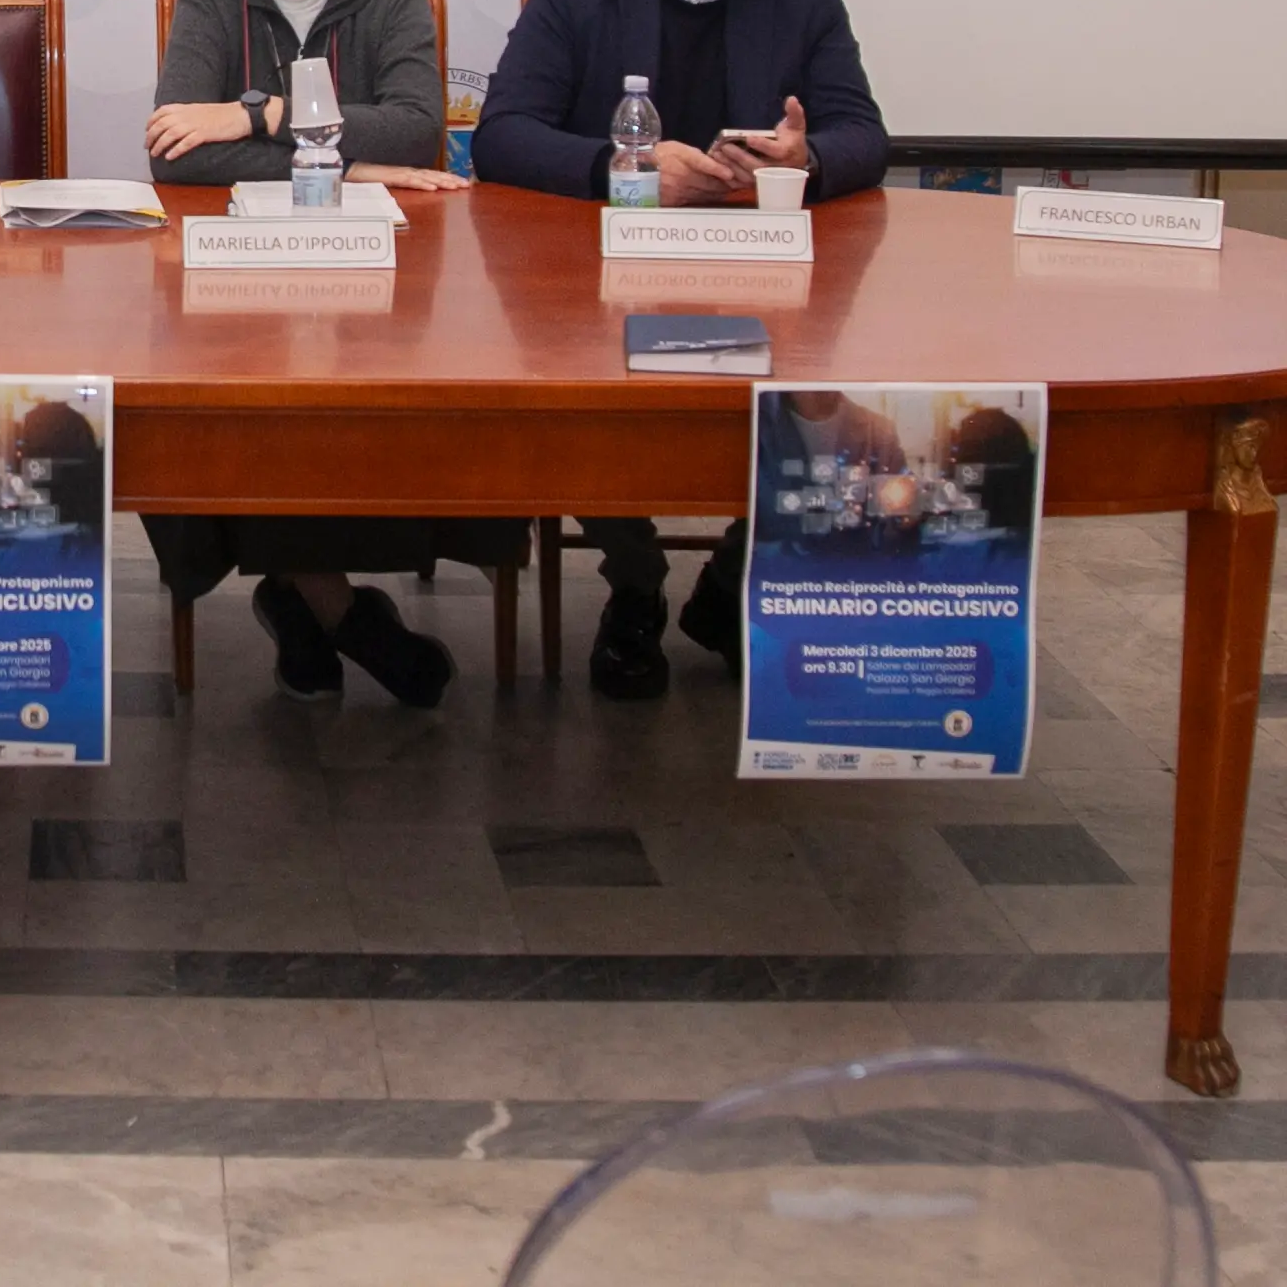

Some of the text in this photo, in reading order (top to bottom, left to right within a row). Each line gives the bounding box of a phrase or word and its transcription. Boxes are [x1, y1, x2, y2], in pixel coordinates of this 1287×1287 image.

[1039, 205, 1201, 231] FRANCESCO URBAN
[619, 227, 795, 244] VITTORIO COLOSIMO
[199, 237, 381, 251] MARIELLA D'IPPOLITO
[761, 581, 823, 595] Progetto
[825, 581, 905, 596] Reciprocità
[919, 581, 1019, 597] Protagonismo
[761, 598, 1019, 617] SEMINARIO CONCLUSIVO
[20, 639, 51, 651] 2025
[871, 646, 878, 657] 3
[880, 645, 944, 657] dicembre
[945, 646, 977, 659] 2025
[805, 663, 825, 673] ore
